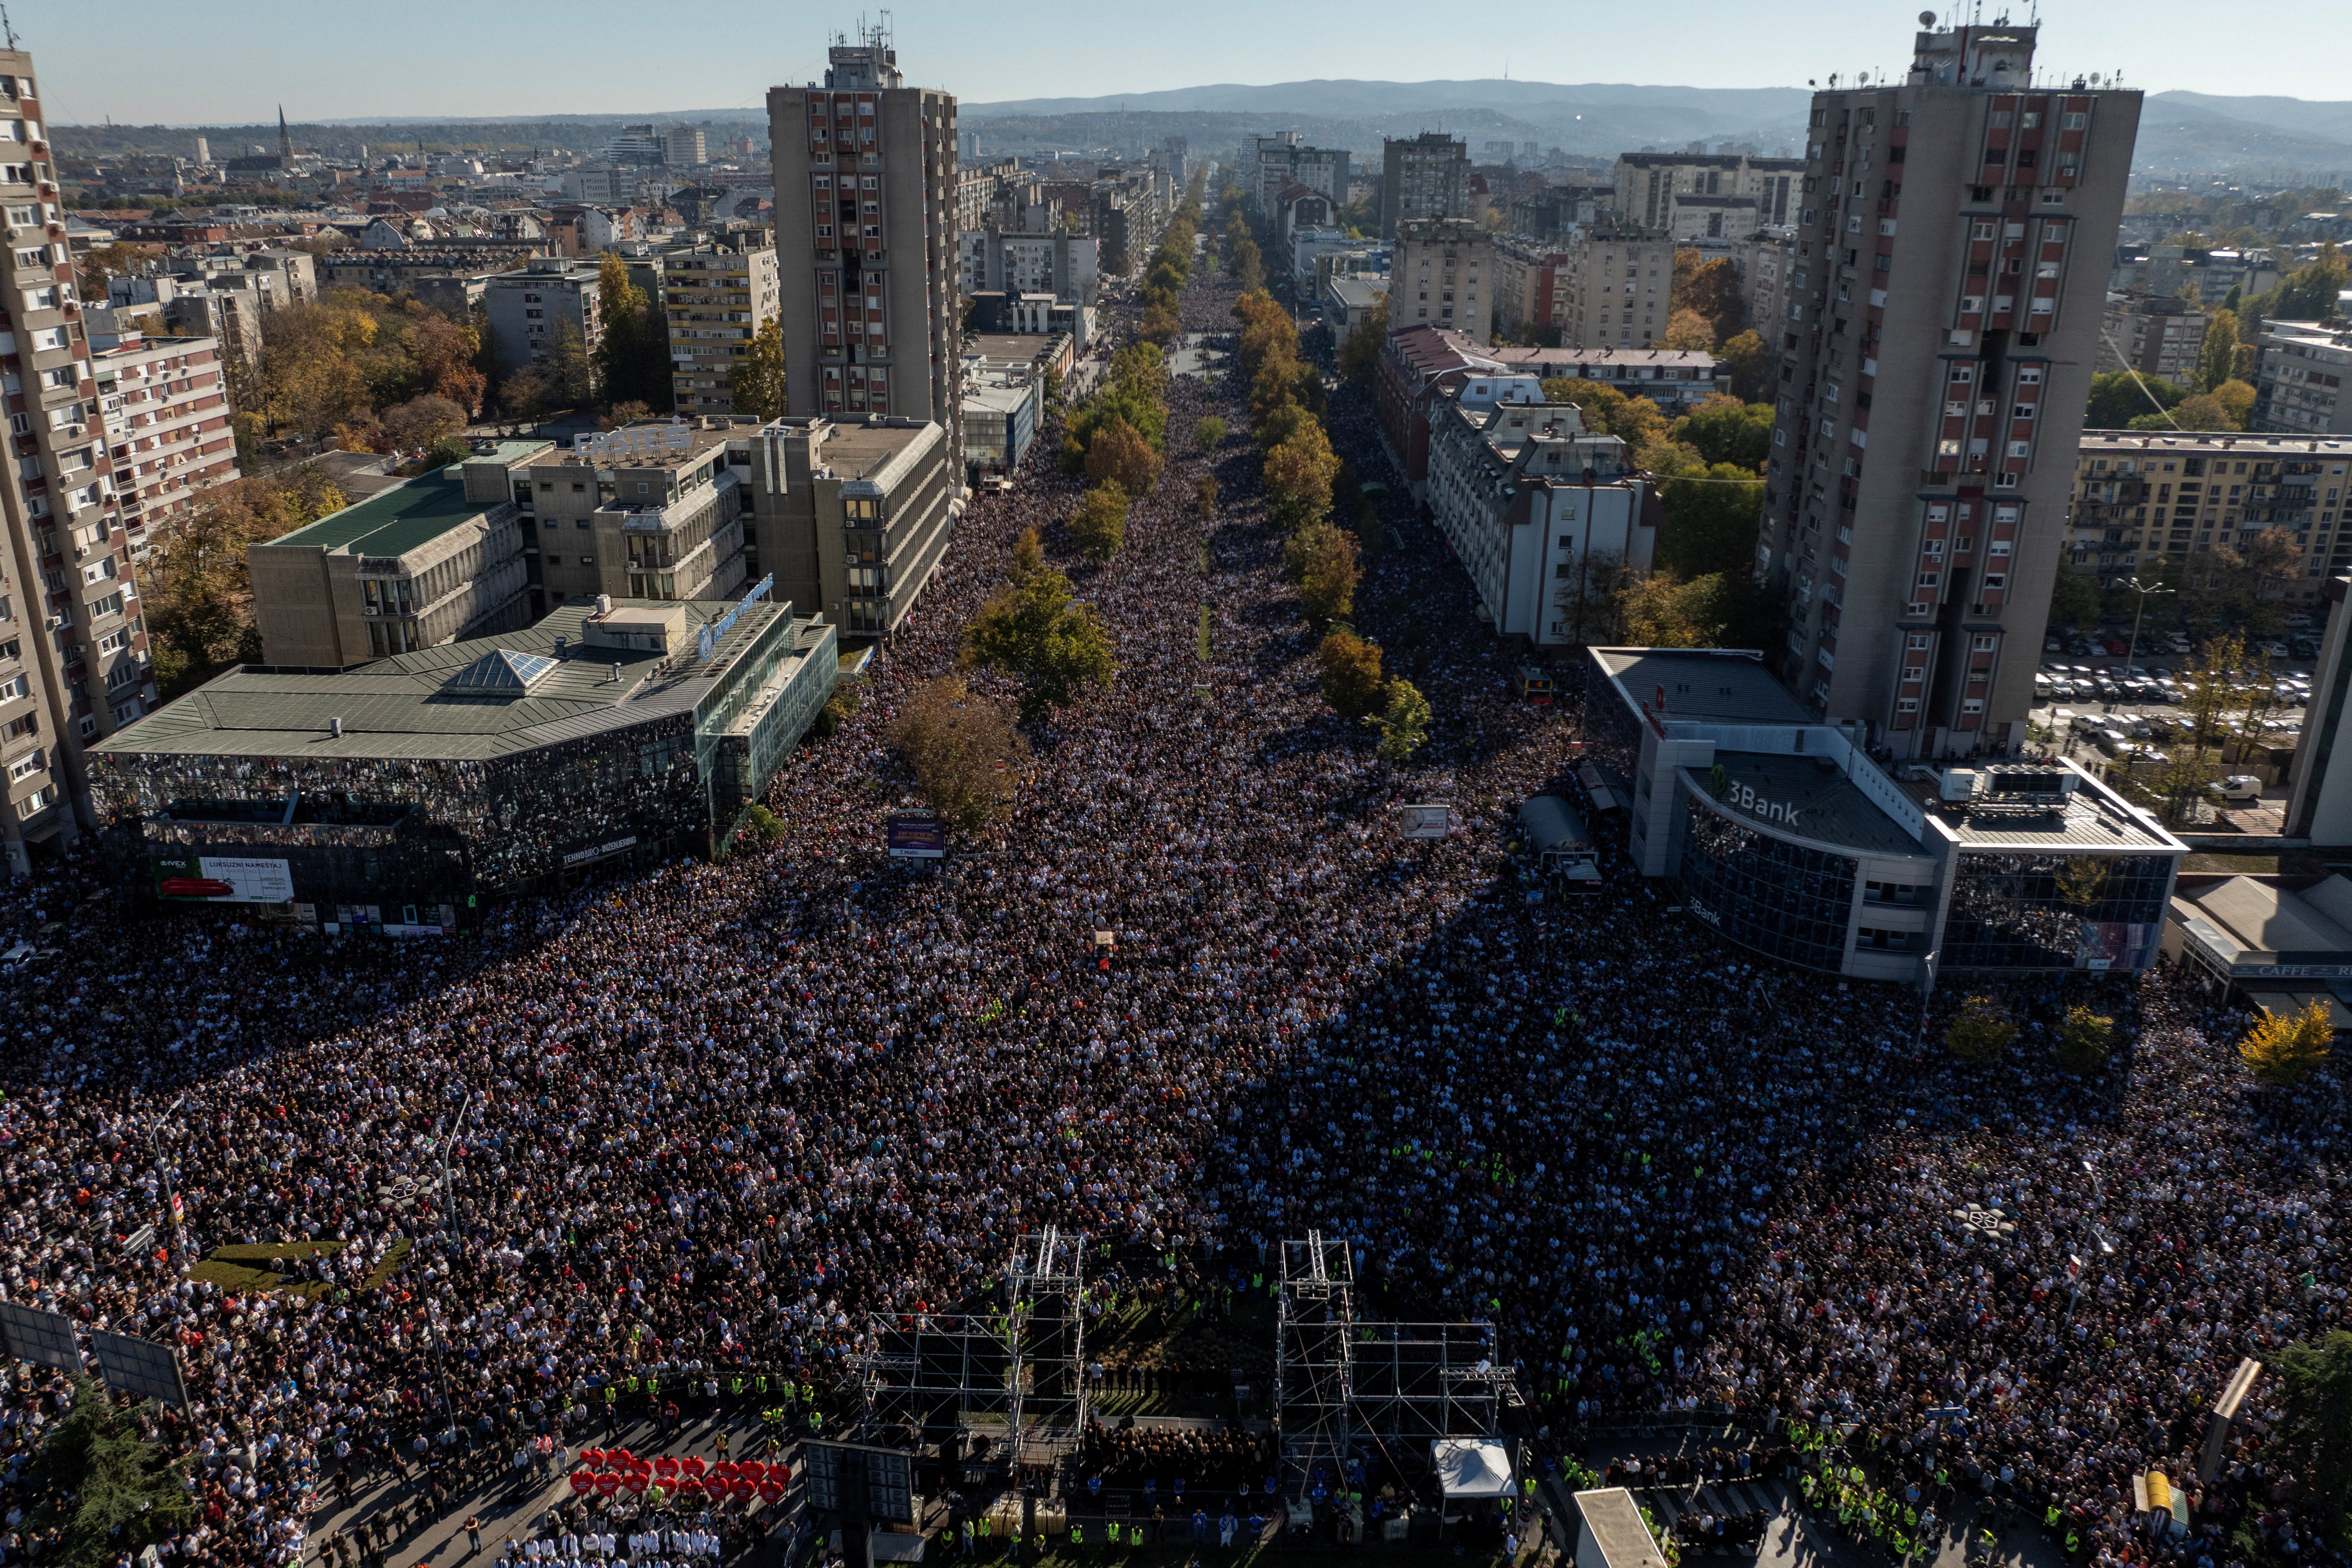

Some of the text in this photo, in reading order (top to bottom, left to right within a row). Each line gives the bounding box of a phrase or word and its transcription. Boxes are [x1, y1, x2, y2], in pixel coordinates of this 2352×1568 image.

[574, 428, 660, 456] ERSTE
[714, 609, 737, 644] ДУНАВ
[1730, 780, 1799, 826] 3Bank
[1689, 896, 1721, 927] 3Bank
[2195, 937, 2230, 971] RESTORAN
[2259, 966, 2311, 976] CAFFE
